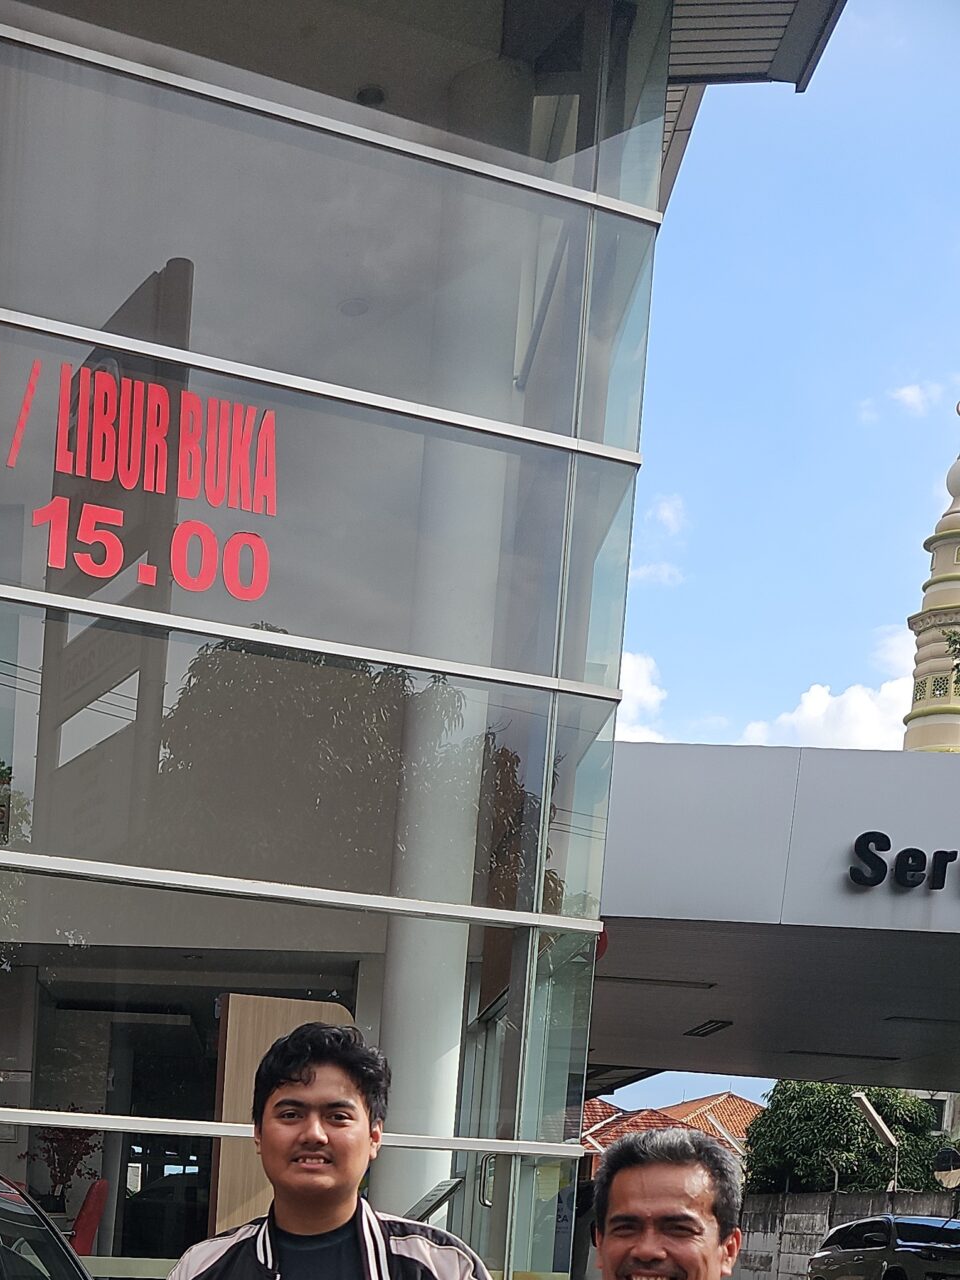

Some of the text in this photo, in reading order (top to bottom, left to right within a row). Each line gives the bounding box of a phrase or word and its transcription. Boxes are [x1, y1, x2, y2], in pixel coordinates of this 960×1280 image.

[7, 360, 42, 468] /
[55, 363, 171, 495] LIBUR
[176, 389, 277, 517] BUKA
[32, 495, 270, 602] 15.00
